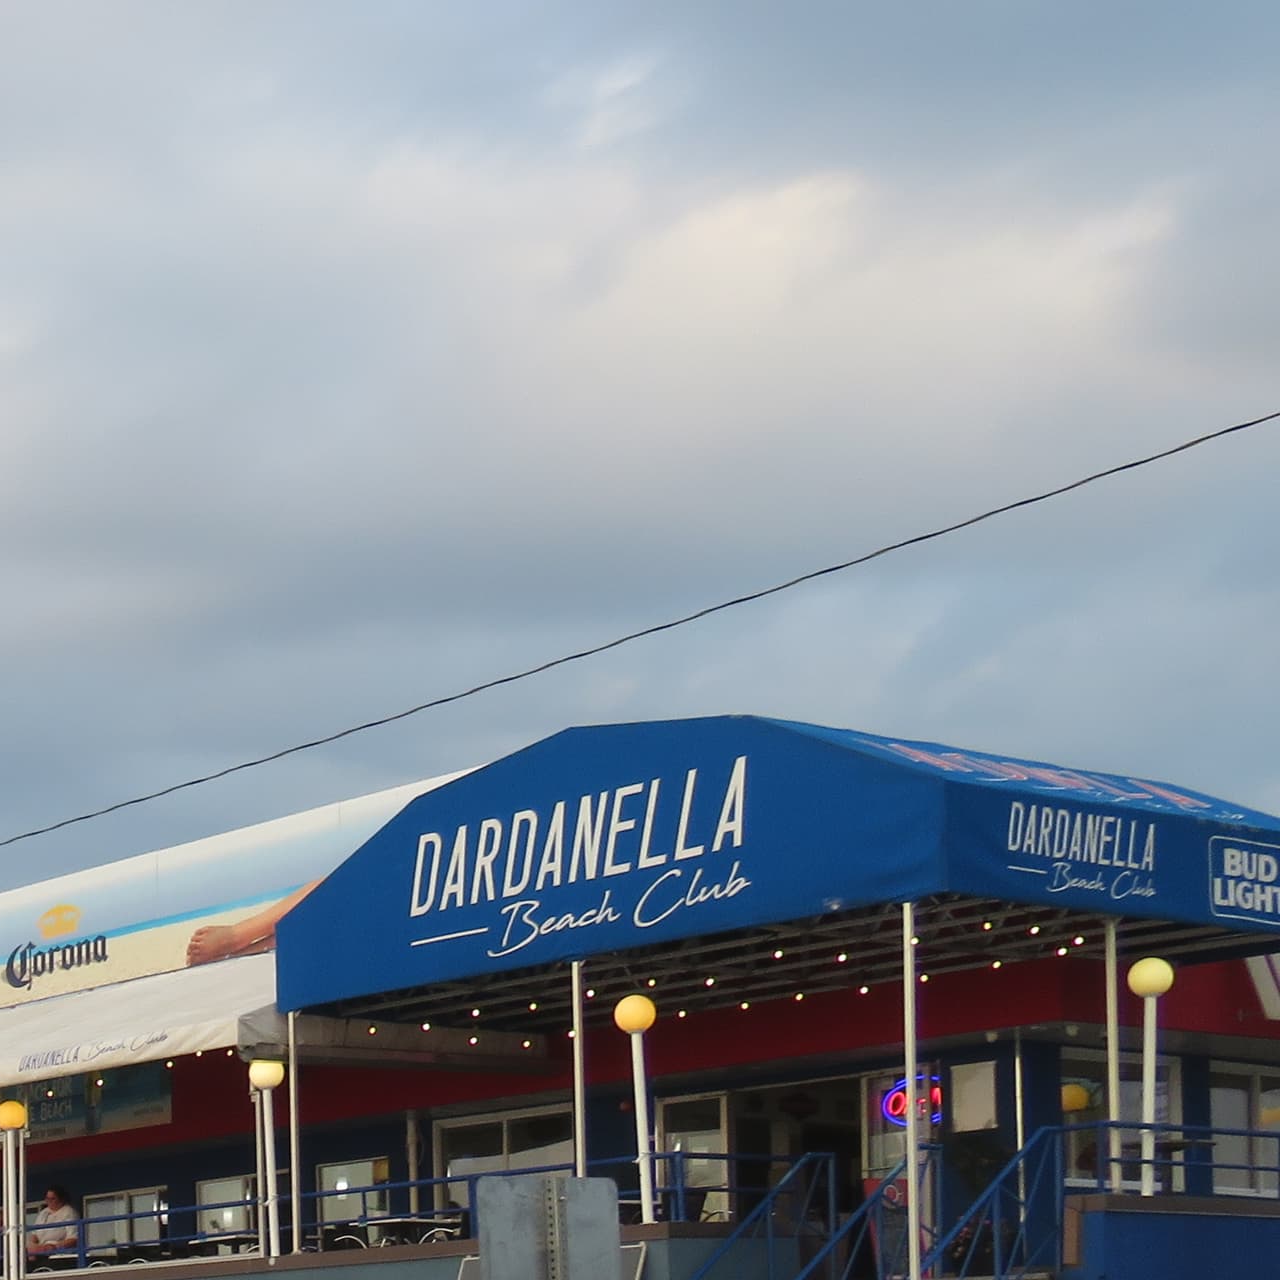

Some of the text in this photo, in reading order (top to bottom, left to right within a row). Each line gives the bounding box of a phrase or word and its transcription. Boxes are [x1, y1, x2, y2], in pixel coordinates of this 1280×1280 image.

[409, 754, 747, 919] DARDANELLA
[1007, 801, 1156, 871] DARDANELLA
[1046, 861, 1157, 900] Beach Club
[1223, 847, 1278, 883] BUD
[487, 860, 752, 957] Beach Club
[6, 935, 109, 991] Corona
[18, 1046, 81, 1073] DARDANELLA
